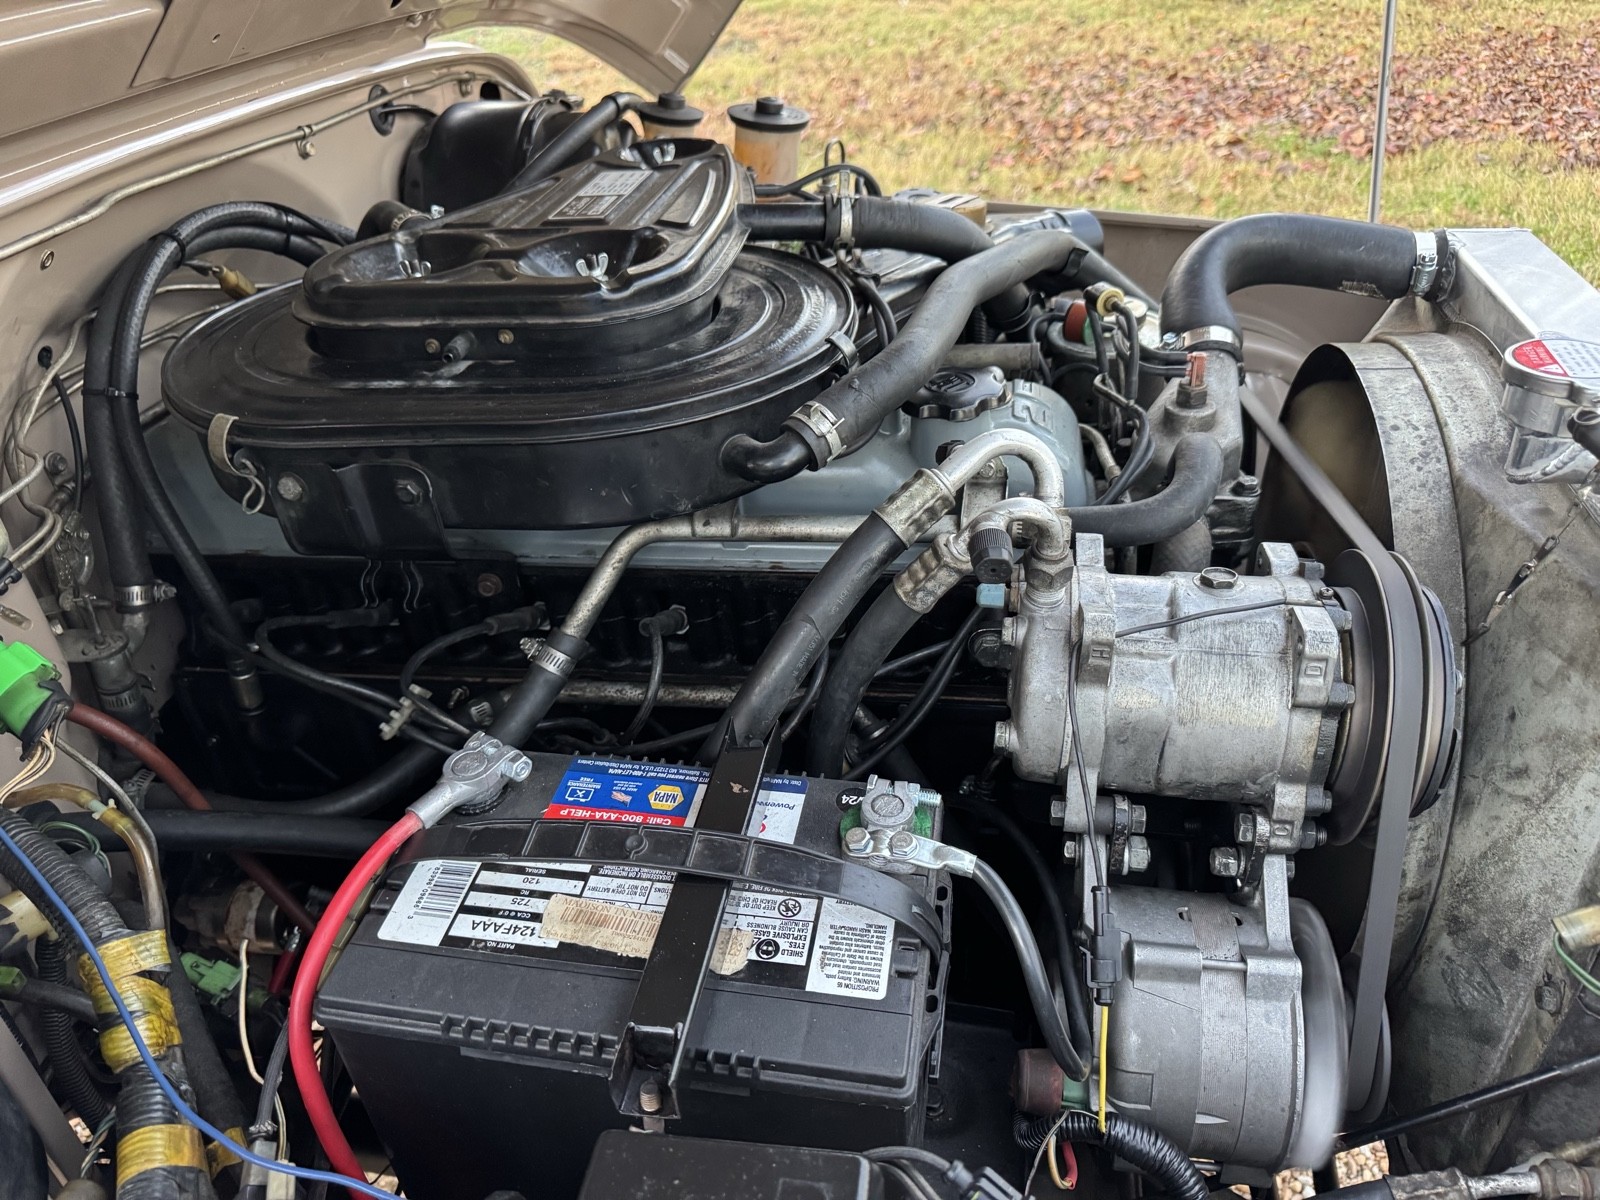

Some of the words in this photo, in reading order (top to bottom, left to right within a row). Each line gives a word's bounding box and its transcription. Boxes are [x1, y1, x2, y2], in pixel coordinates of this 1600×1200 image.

[595, 760, 619, 768] Distribution
[653, 792, 679, 803] NAPA
[560, 808, 644, 823] 800-AAA-HELP
[647, 817, 671, 825] Call:
[522, 876, 541, 885] 120
[636, 872, 672, 880] DISASSEMBLE
[587, 885, 610, 894] BATTERY.
[511, 897, 531, 906] 725
[563, 898, 611, 914] MADISON
[613, 907, 627, 916] TN
[471, 920, 538, 938] 124FAAA
[747, 922, 776, 931] BLINDNESS
[772, 931, 807, 941] EXPLOSIVE
[781, 949, 804, 957] SHIELD
[852, 977, 879, 986] WARNING:
[844, 983, 879, 992] PROPOSITION
